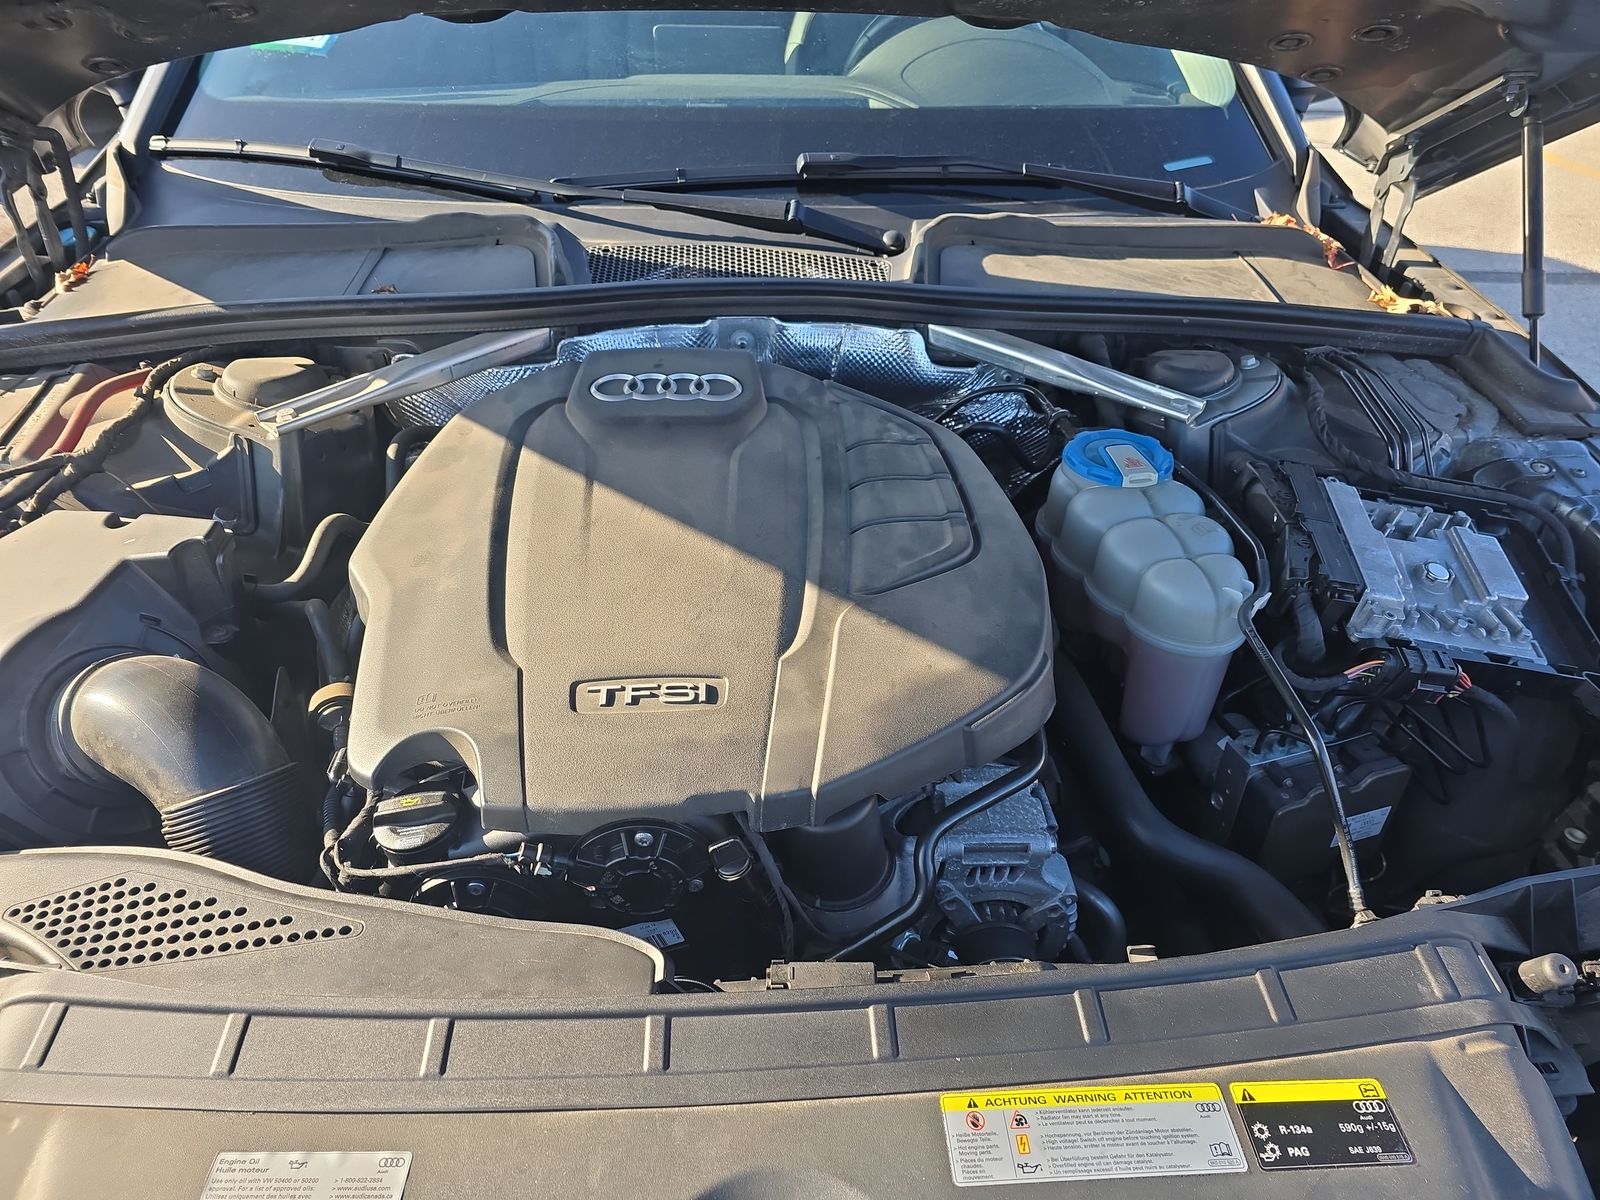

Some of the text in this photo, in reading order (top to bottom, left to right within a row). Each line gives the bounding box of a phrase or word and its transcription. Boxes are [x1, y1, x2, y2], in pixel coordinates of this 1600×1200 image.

[587, 682, 708, 707] TFSI
[985, 1090, 1192, 1107] ACHTUNG WARNING ATTENTION
[1279, 1124, 1314, 1135] R-134a
[1338, 1121, 1397, 1134] 590g +/-15g
[1287, 1146, 1311, 1157] PAG
[1349, 1145, 1383, 1154] SAE J639
